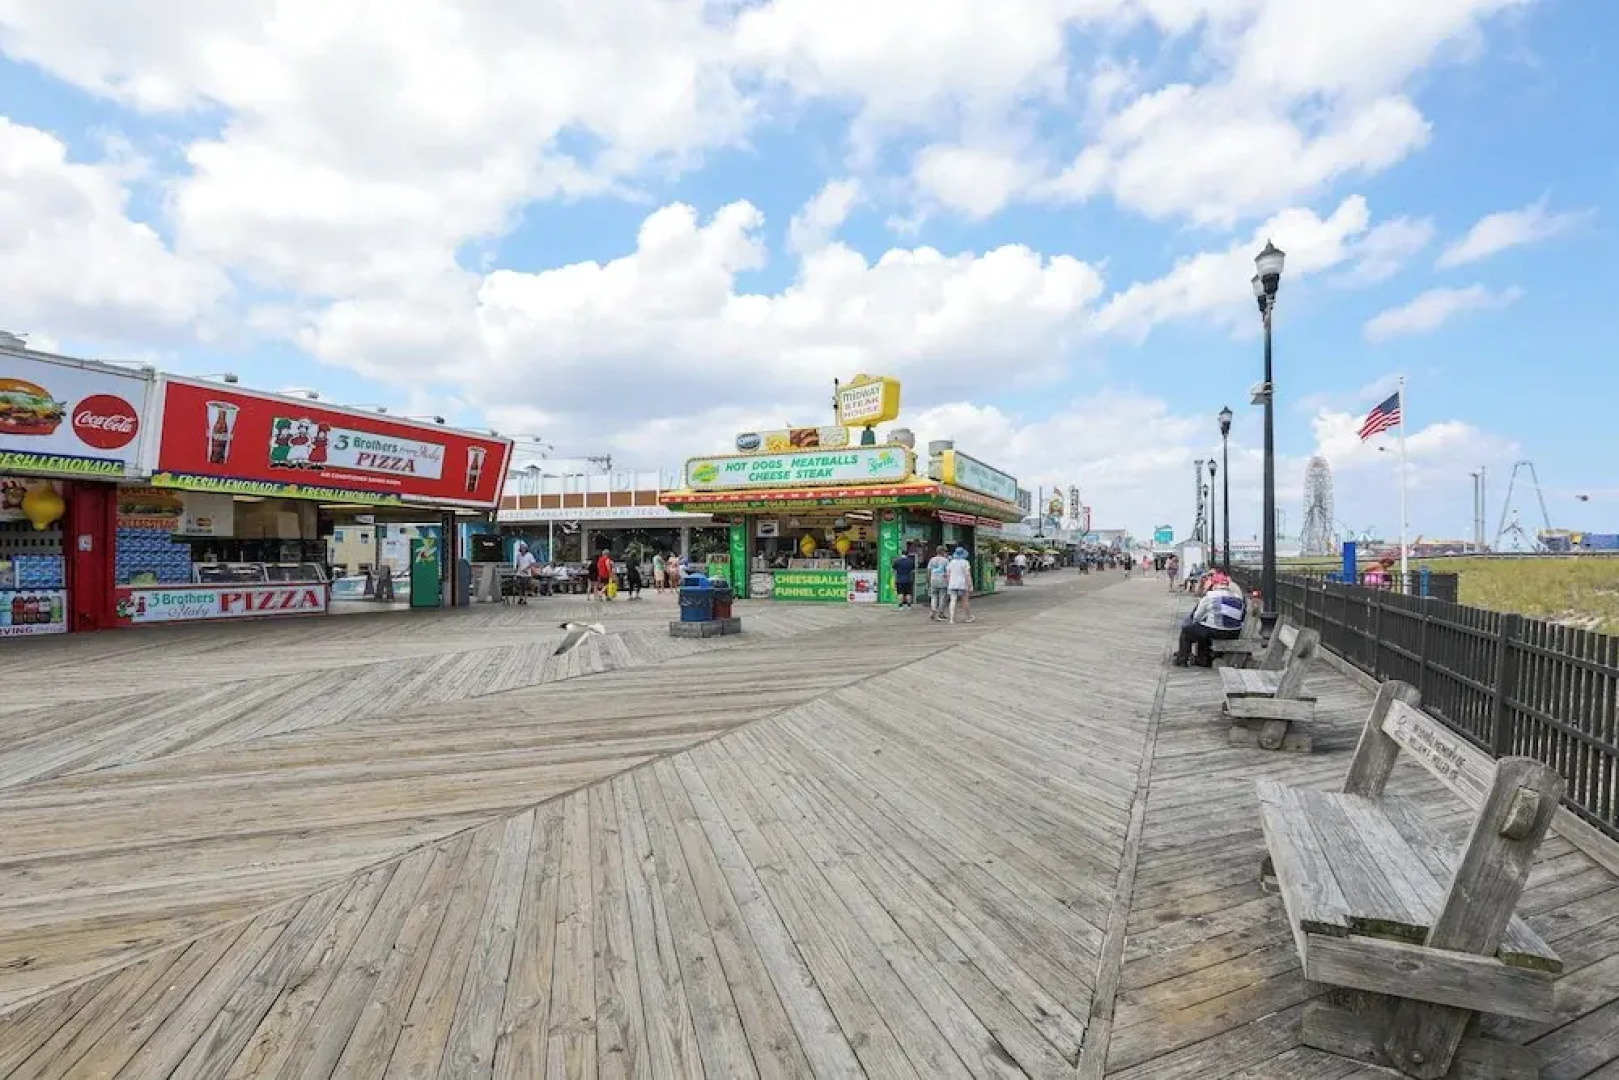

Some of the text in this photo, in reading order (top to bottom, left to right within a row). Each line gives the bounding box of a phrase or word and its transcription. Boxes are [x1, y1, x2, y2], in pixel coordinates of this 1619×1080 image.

[843, 404, 880, 419] HOUSE
[844, 396, 880, 410] STEAK
[75, 410, 137, 433] Coca-Cola
[334, 434, 349, 451] 3
[352, 436, 398, 453] Brothers
[38, 455, 122, 473] LEMONADE
[355, 452, 416, 474] PIZZA
[725, 462, 748, 472] HOT
[752, 459, 783, 471] DOGS
[790, 454, 859, 467] MEATBALLS
[748, 467, 834, 482] CHEESE STEAK
[177, 475, 280, 493] FRESH LEMONADE
[302, 485, 382, 501] FRESH LEMONADE
[775, 574, 847, 585] CHEESEBALLS
[148, 589, 320, 613] 3 Brothers PIZZA
[775, 587, 816, 597] FUNNEL
